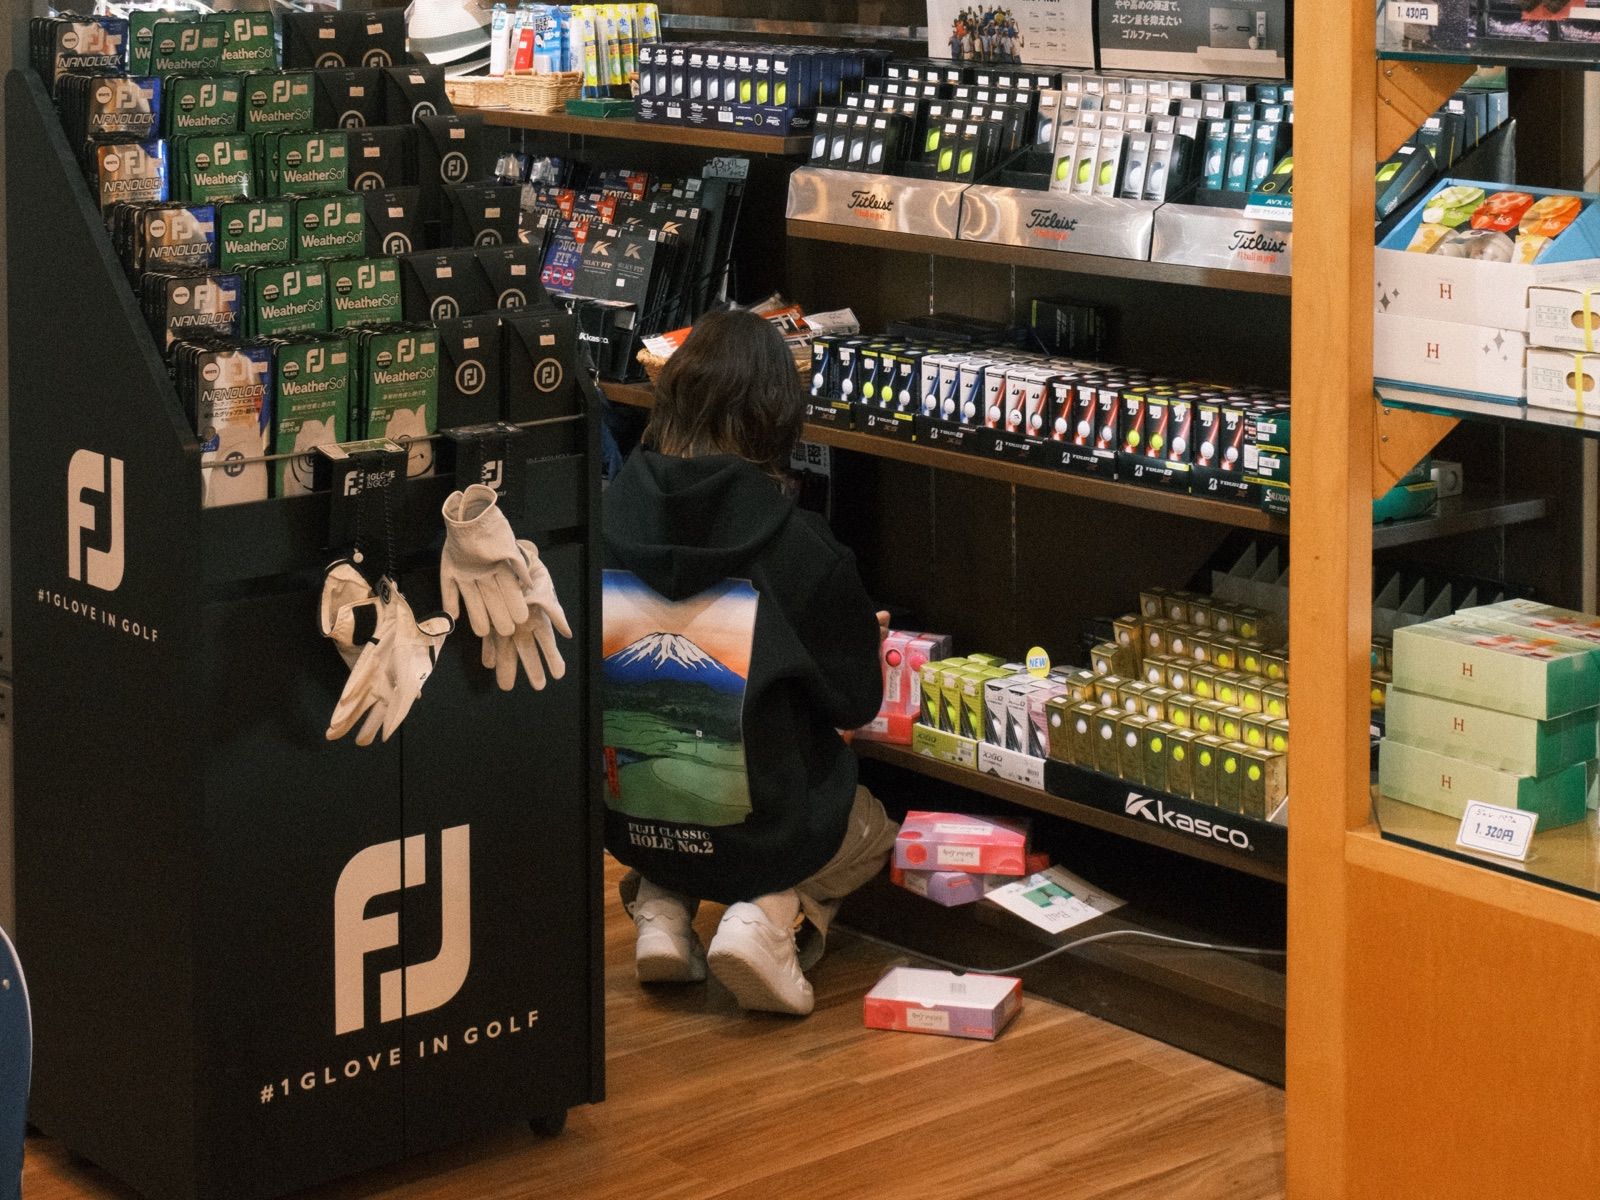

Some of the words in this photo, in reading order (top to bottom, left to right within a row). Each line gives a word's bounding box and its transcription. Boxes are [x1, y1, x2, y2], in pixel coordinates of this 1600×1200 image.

[181, 29, 199, 51] FJ
[234, 19, 250, 41] FJ
[1122, 29, 1169, 40] ゴルファーへ
[59, 55, 122, 68] NANOLOCK
[157, 55, 218, 70] WeatherSof
[200, 84, 217, 107] FJ
[273, 80, 290, 103] FJ
[92, 113, 156, 125] NANOLOCK
[178, 112, 235, 127] WeatherSof
[250, 109, 312, 122] WeatherSof
[214, 142, 231, 165] FJ
[307, 140, 323, 162] FJ
[283, 167, 346, 182] WeatherSof
[847, 190, 894, 211] Titleist
[248, 209, 266, 233] FJ
[324, 203, 341, 226] FJ
[1026, 209, 1078, 231] Titleist
[150, 242, 212, 257] NANOLOCK
[225, 238, 288, 254] WeatherSof
[302, 231, 362, 248] WeatherSof
[1229, 230, 1287, 253] Titleist
[283, 271, 301, 296] FJ
[357, 265, 376, 289] FJ
[261, 297, 324, 319] WeatherSof
[335, 292, 400, 311] WeatherSof
[170, 311, 237, 327] NANOLOCK
[306, 348, 325, 373] FJ
[397, 338, 416, 363] FJ
[373, 367, 437, 385] WeatherSof
[464, 368, 478, 386] FJ
[541, 366, 554, 384] FJ
[202, 384, 268, 401] NANOLOCK
[282, 376, 348, 396] WeatherSof
[67, 448, 124, 591] FJ
[102, 611, 116, 627] IN
[122, 619, 158, 642] GOLF
[1029, 658, 1046, 669] NEW
[628, 822, 655, 835] FUJI
[659, 827, 710, 840] CLASSIC
[629, 832, 674, 850] HOLE
[677, 840, 714, 854] No.2
[334, 824, 470, 1035] FJ
[419, 1035, 448, 1058] IN
[463, 1010, 539, 1044] GOLF
